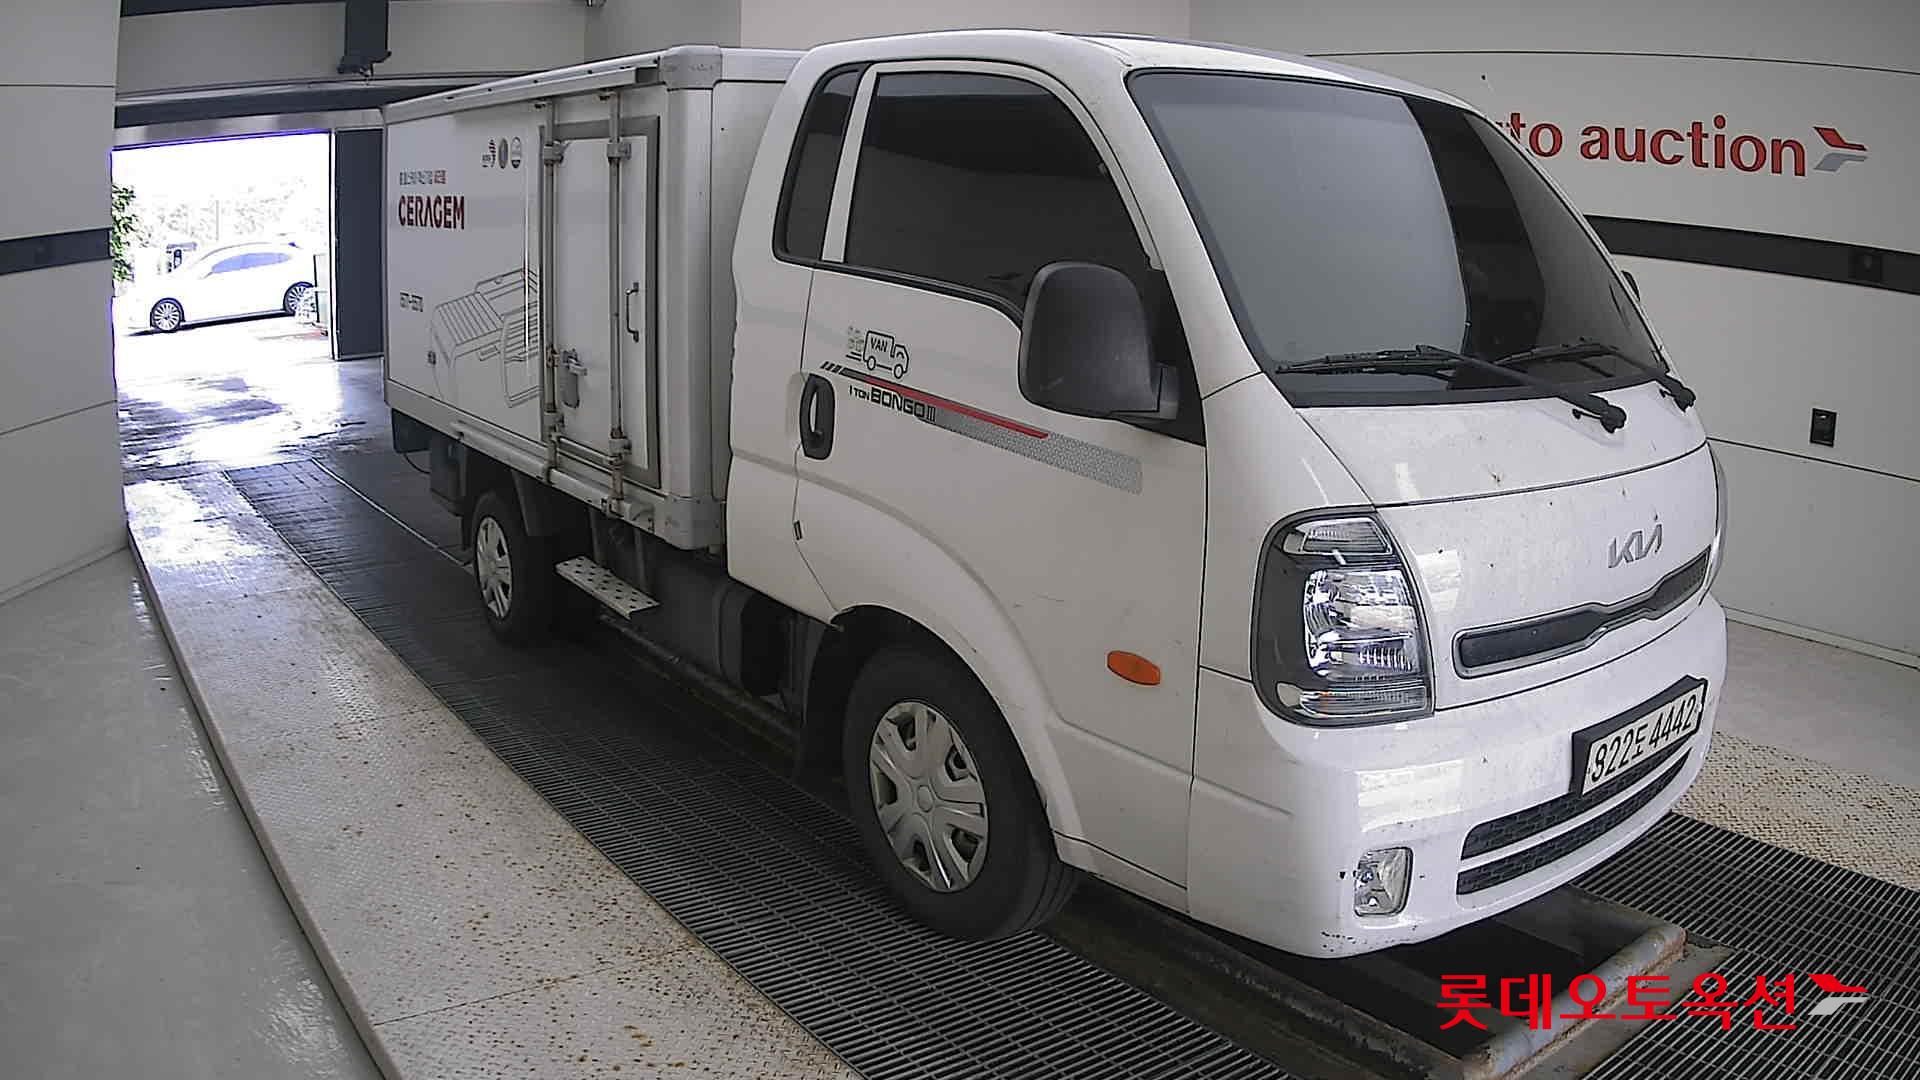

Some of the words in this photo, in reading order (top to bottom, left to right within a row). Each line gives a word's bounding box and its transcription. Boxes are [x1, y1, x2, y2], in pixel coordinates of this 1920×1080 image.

[1495, 112, 1563, 157] to
[1579, 114, 1806, 177] auction
[398, 194, 465, 230] CERAGEM
[870, 336, 888, 353] VAN
[870, 386, 926, 418] BONGO
[1607, 523, 1663, 569] KIA
